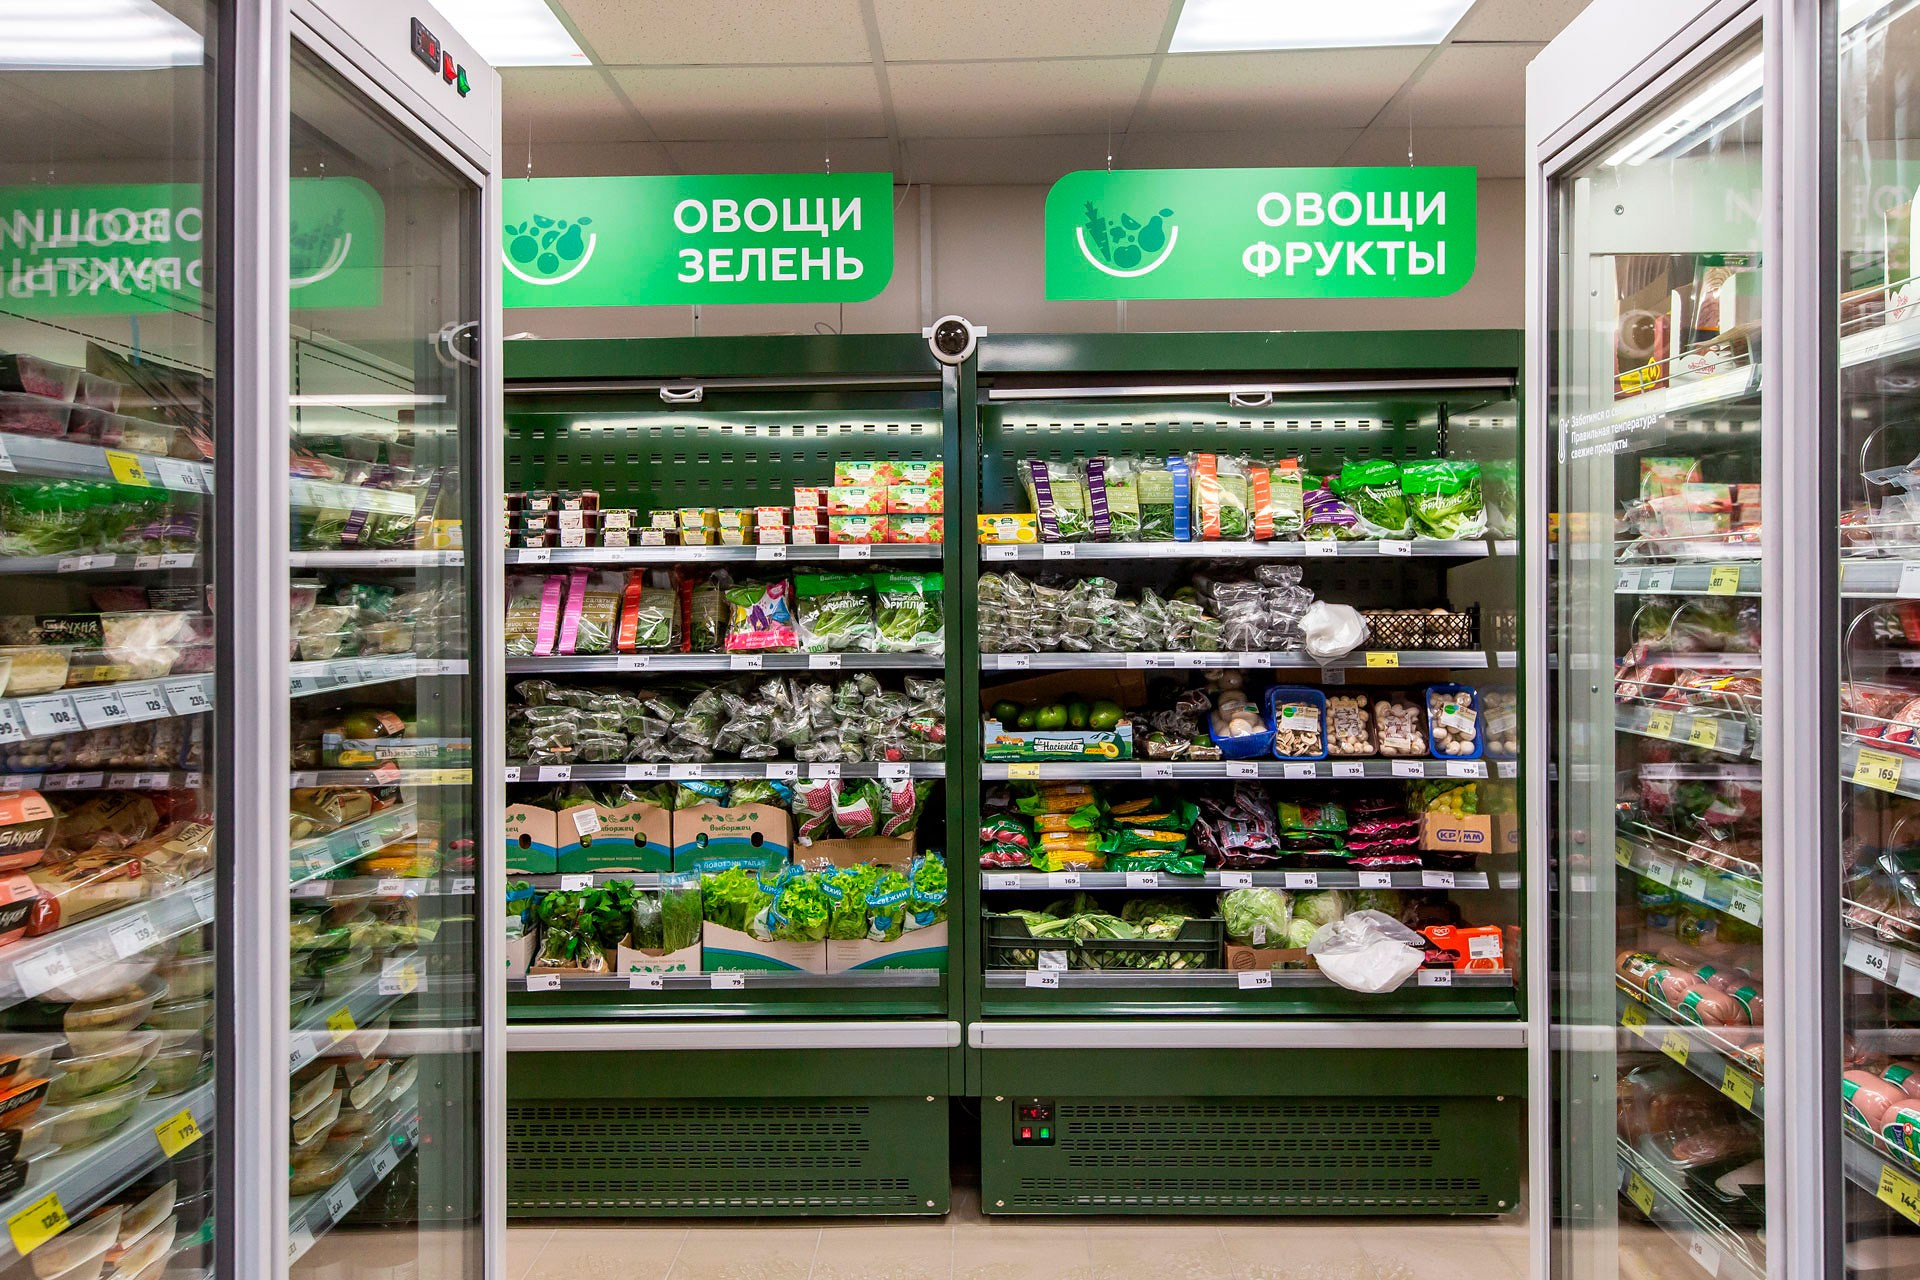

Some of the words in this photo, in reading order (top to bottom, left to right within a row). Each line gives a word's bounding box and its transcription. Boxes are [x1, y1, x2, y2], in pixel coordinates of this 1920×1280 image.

[673, 198, 862, 237] ОВОЩИ
[1257, 191, 1446, 232] ОВОЩИ
[677, 247, 864, 283] ЗЕЛЕНЬ
[1241, 240, 1446, 278] ФРУКТЫ
[1571, 425, 1611, 445] Правильная
[1611, 414, 1657, 433] температура
[1571, 446, 1594, 460] свежие
[1594, 438, 1629, 457] продукты
[1042, 741, 1080, 752] Hacienda
[1878, 768, 1894, 780] 169
[709, 824, 751, 832] Выборжец
[1866, 954, 1883, 969] 549
[1901, 1191, 1917, 1211] 144
